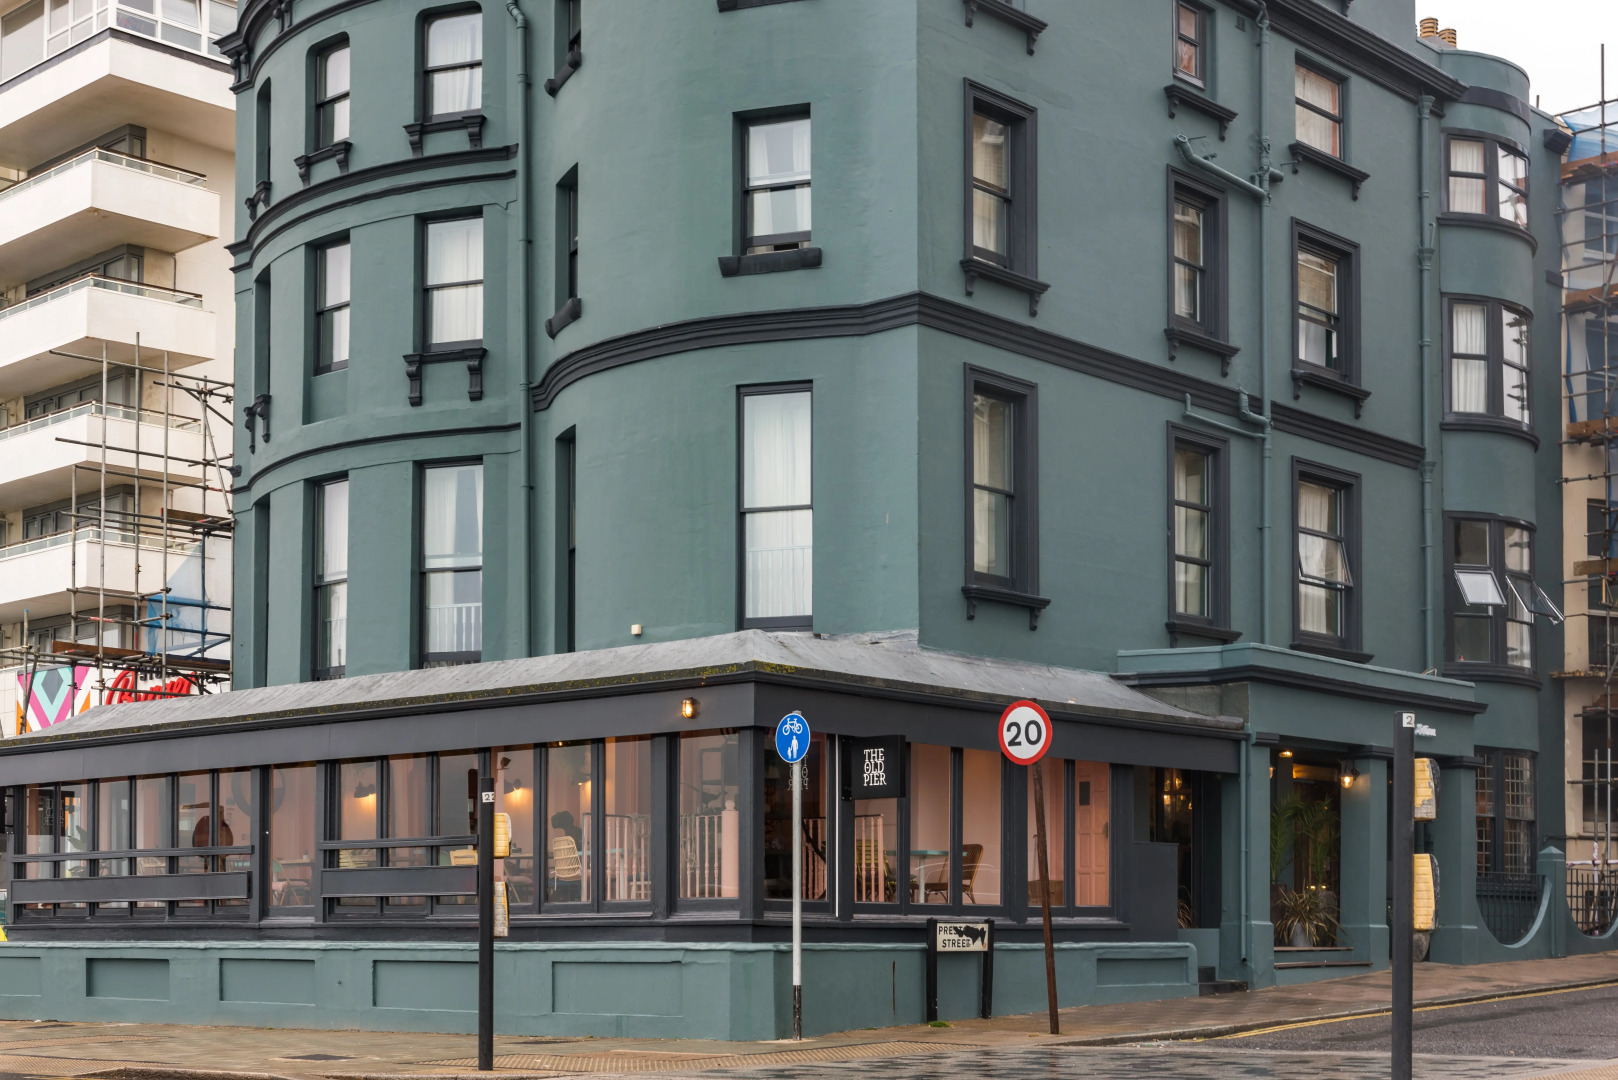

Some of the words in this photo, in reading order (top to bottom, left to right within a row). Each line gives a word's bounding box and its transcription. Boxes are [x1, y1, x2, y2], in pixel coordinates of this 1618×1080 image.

[1006, 720, 1042, 747] 20
[863, 748, 885, 761] THE
[863, 760, 885, 774] OLD
[863, 772, 887, 787] PIER
[942, 938, 971, 949] STREET
